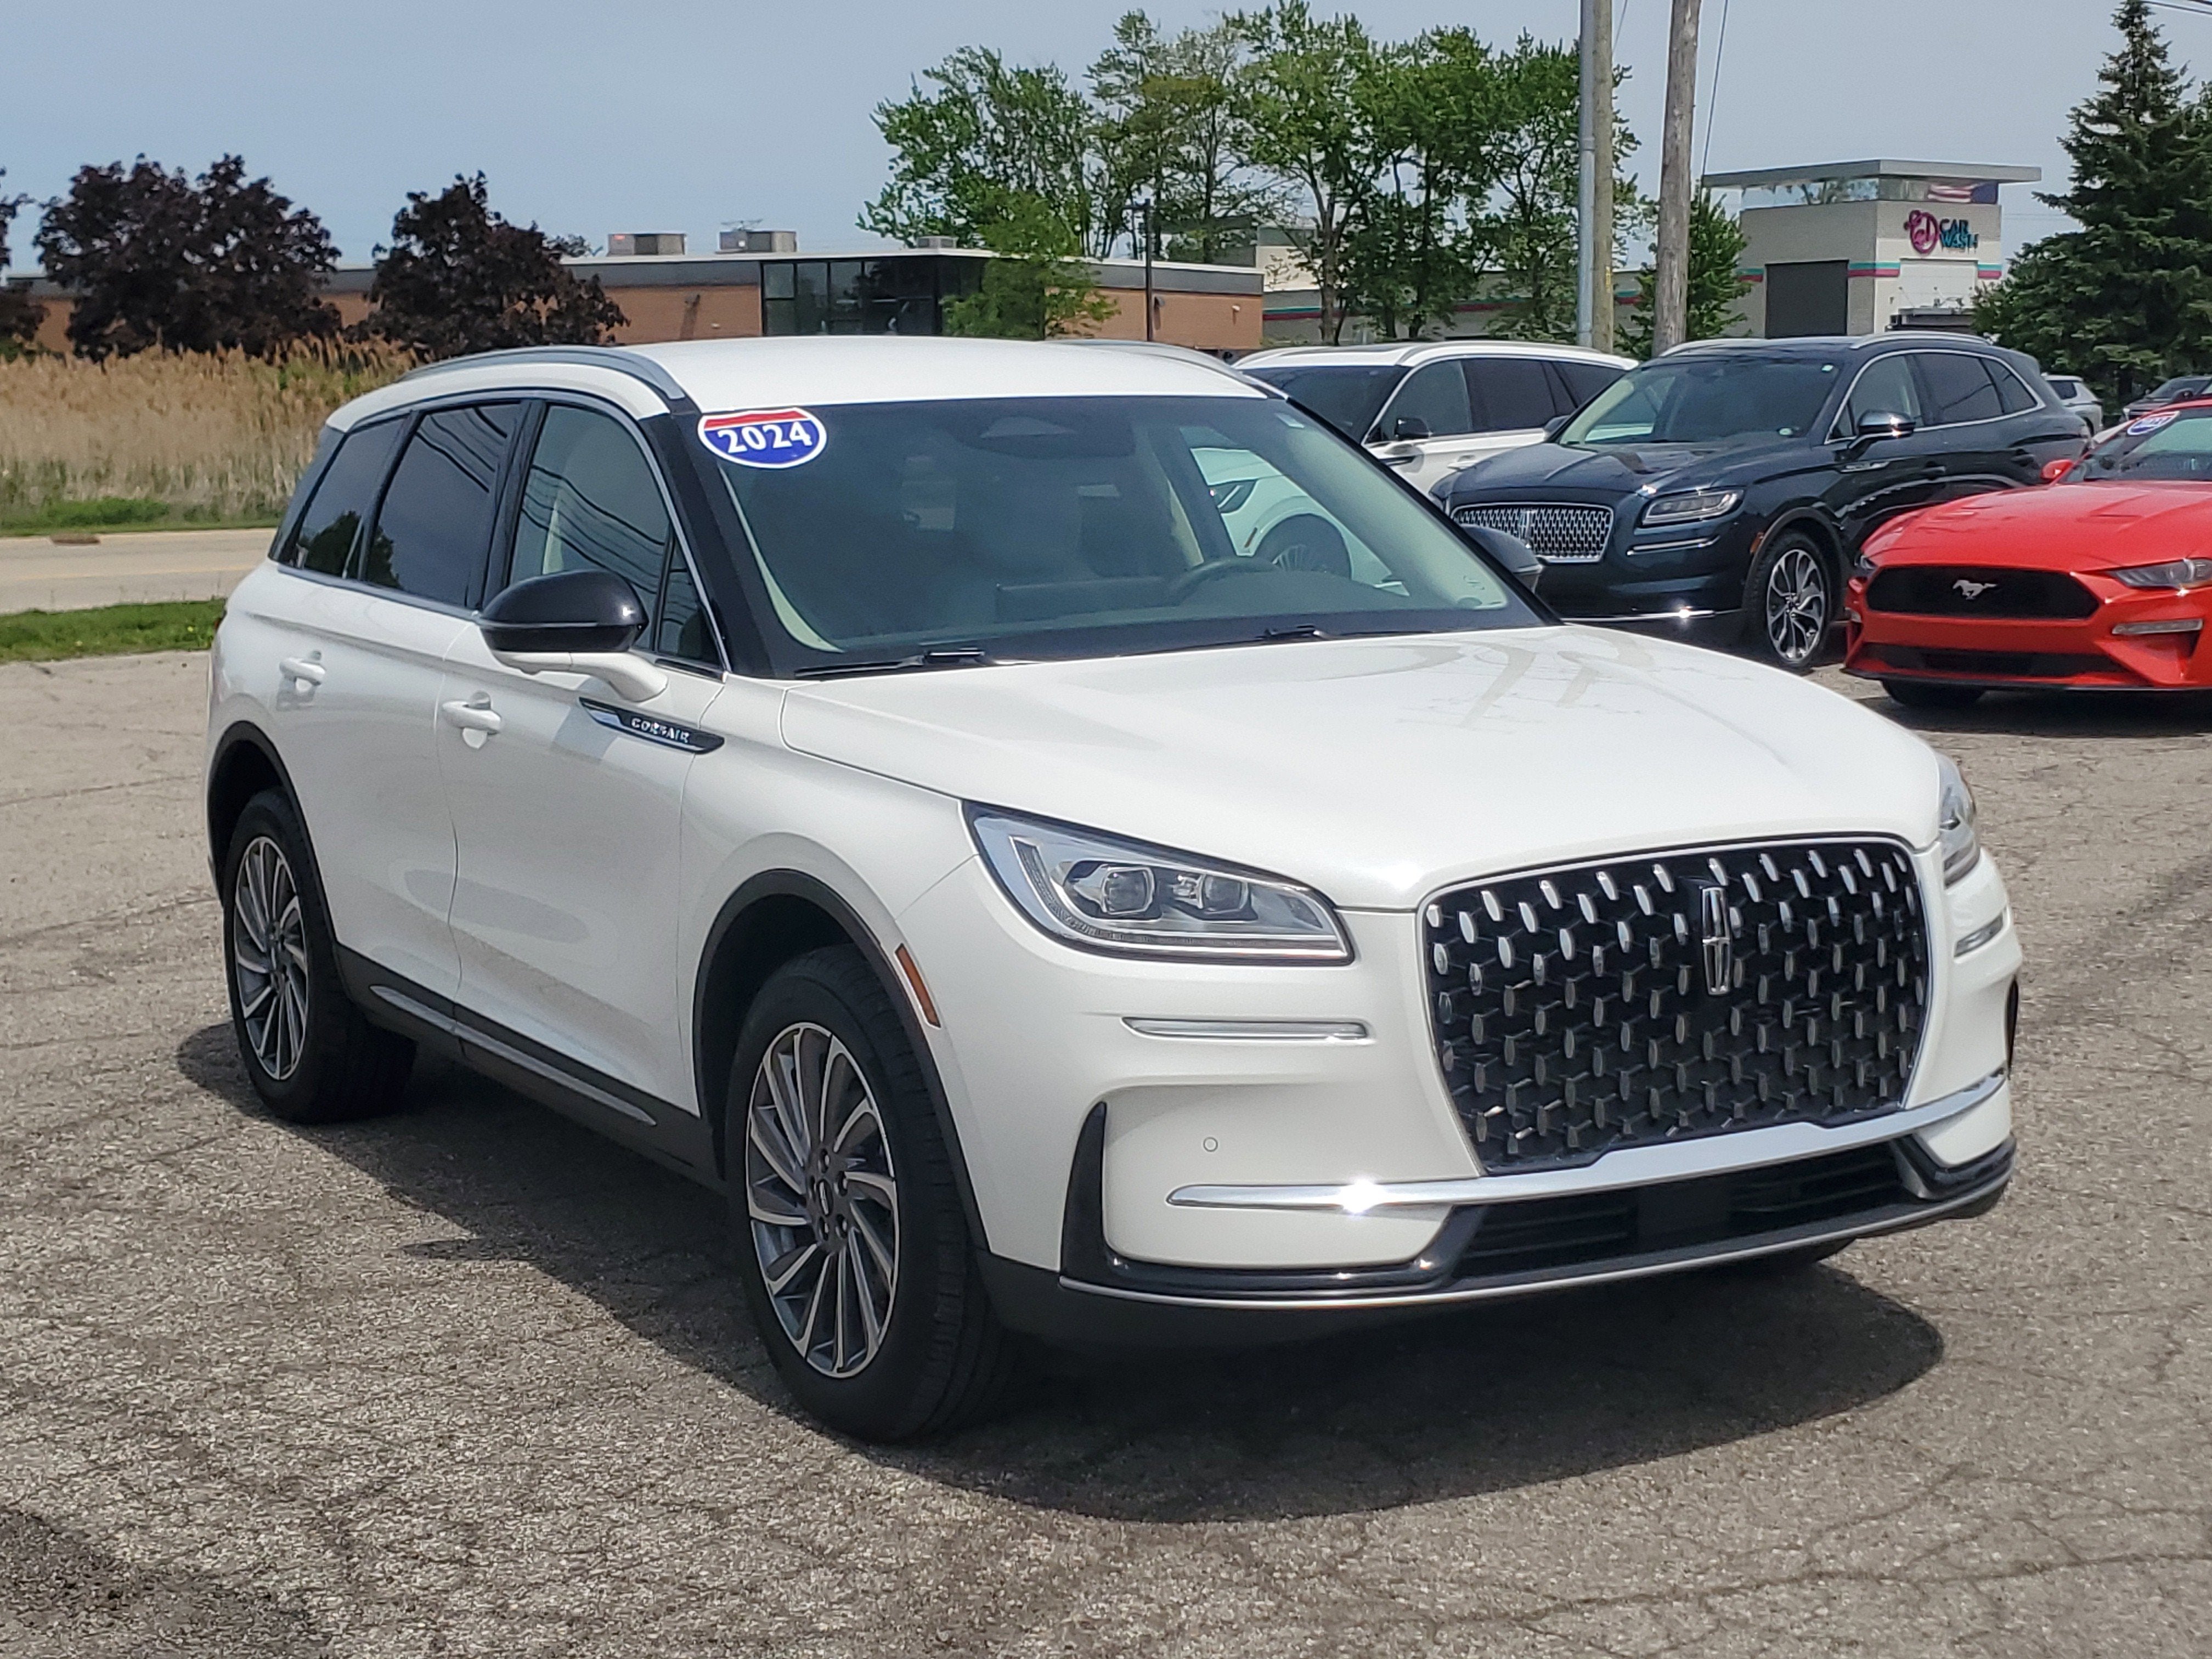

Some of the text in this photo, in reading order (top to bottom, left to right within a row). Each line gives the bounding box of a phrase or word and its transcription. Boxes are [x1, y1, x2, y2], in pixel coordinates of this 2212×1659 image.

[1939, 218, 1968, 233] CAR
[1939, 233, 1979, 251] WASH
[717, 421, 812, 454] 2024
[631, 717, 690, 743] CORSAIR
